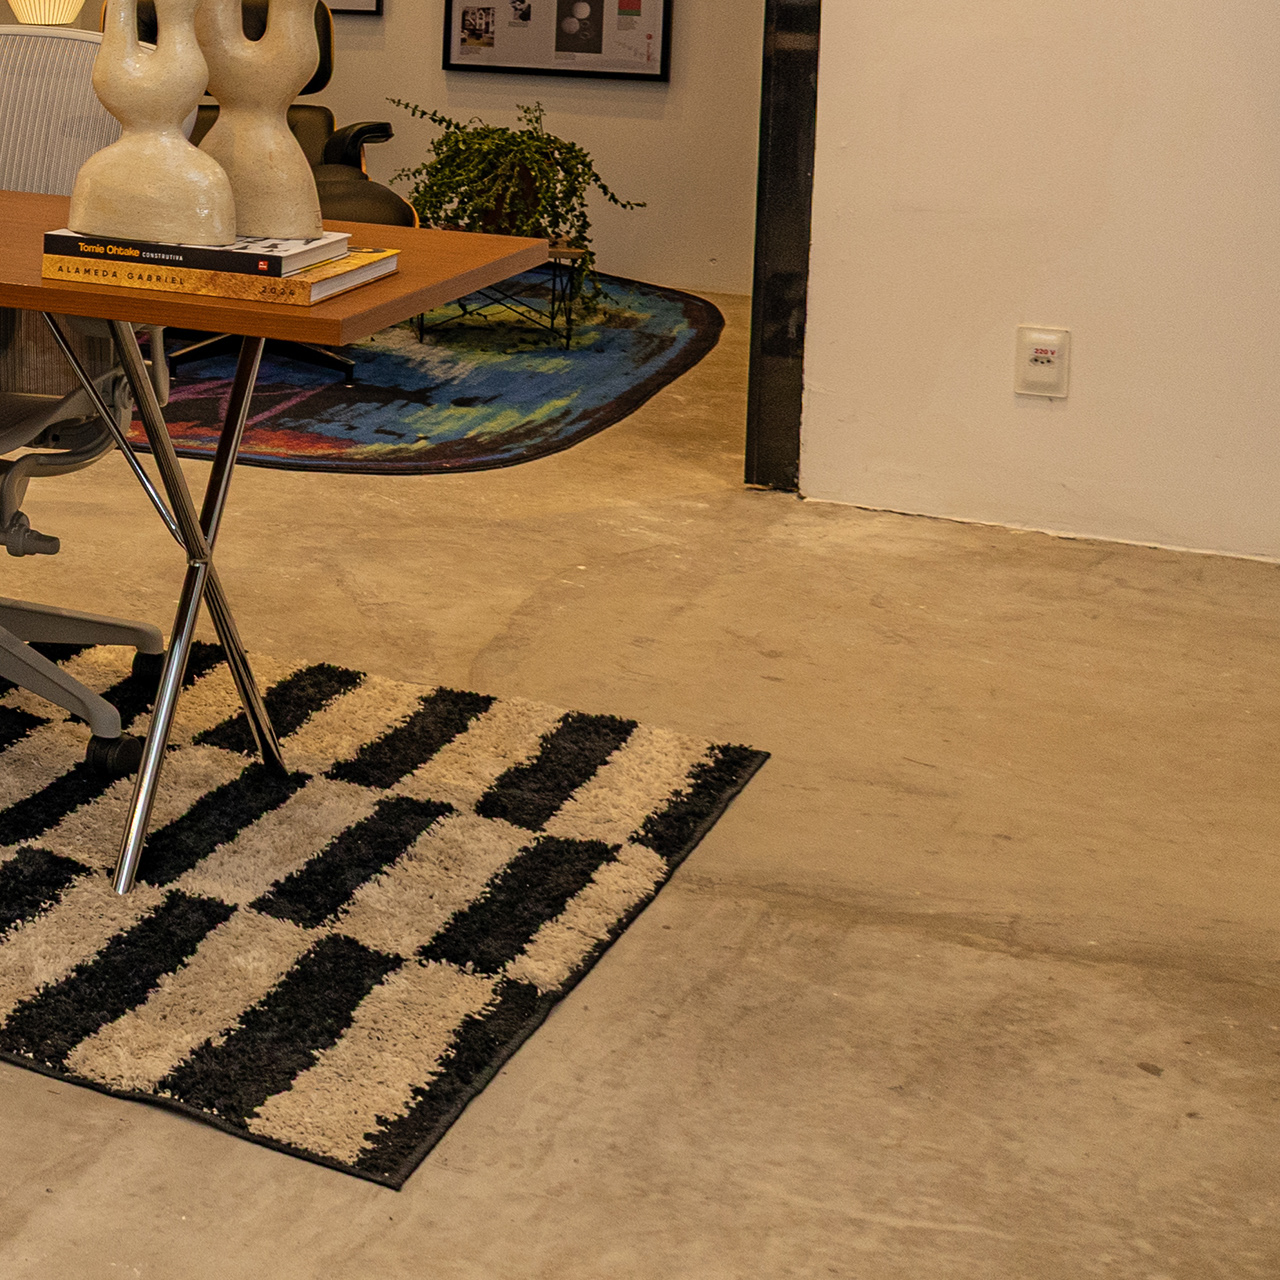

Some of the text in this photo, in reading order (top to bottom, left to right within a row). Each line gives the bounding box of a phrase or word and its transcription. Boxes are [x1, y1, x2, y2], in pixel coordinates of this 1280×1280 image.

[78, 242, 183, 261] Tomie Ohtake CONSTRUTIVA
[58, 265, 185, 285] ALAMEDA GABRIEL
[262, 286, 295, 296] 2024
